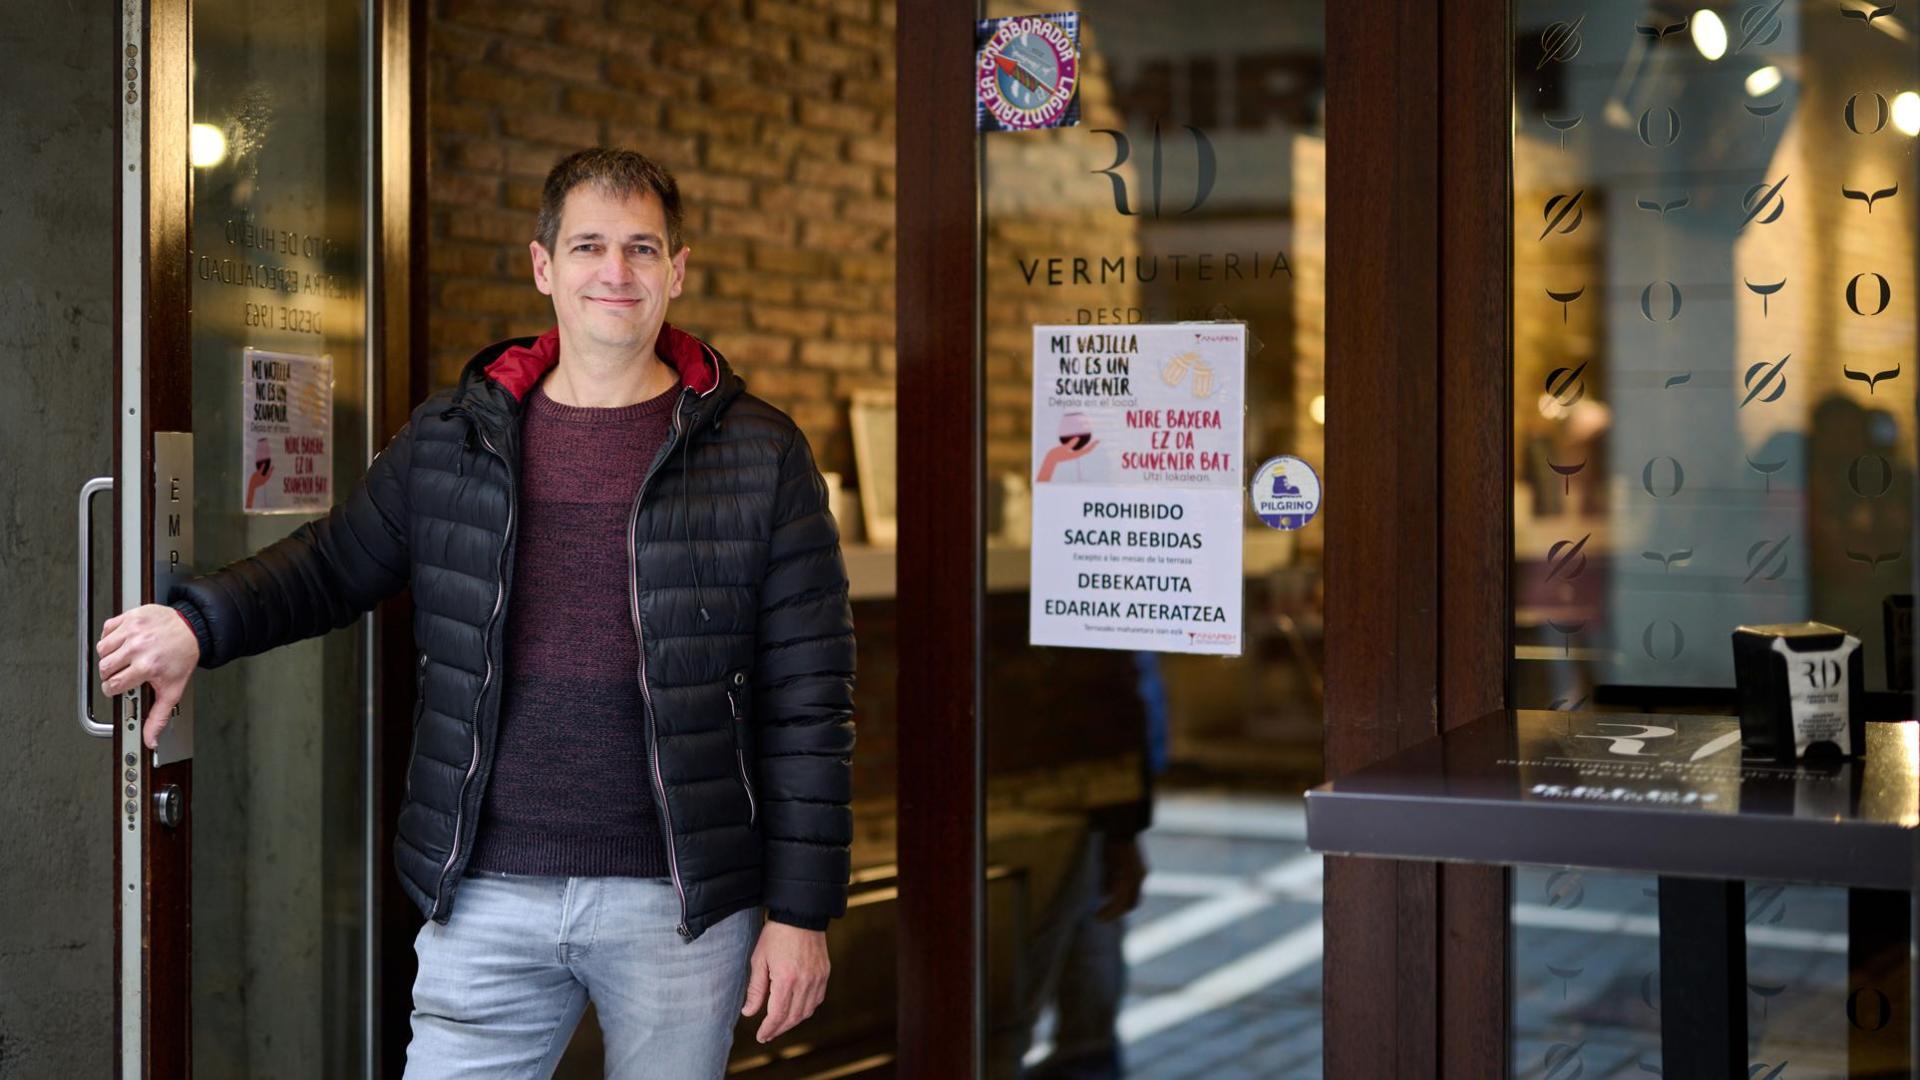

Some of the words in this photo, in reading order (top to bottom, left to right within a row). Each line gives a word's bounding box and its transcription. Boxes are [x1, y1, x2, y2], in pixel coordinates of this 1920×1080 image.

[982, 18, 1074, 70] COLABORADOR
[980, 76, 1075, 126] LAGUNTZAILEA
[1018, 251, 1293, 286] VERMUTERIA
[1051, 335, 1071, 354] MI
[1077, 334, 1139, 354] VAJILLA
[1059, 357, 1080, 376] NO
[1085, 357, 1101, 375] ES
[1107, 357, 1129, 375] UN
[1126, 410, 1161, 429] NIRE
[1166, 410, 1222, 429] BAXERA
[1151, 431, 1170, 449] EZ
[1176, 431, 1194, 450] DA
[1121, 452, 1195, 471] SOUVENIR
[1083, 502, 1184, 520] PROHIBIDO
[1260, 500, 1313, 511] PILGRINO
[1064, 529, 1121, 546] SACAR
[1127, 531, 1202, 549] BEBIDAS
[1078, 573, 1192, 593] DEBEKATUTA
[1045, 599, 1121, 618] EDARIAK
[1126, 603, 1226, 623] ATERATZEA
